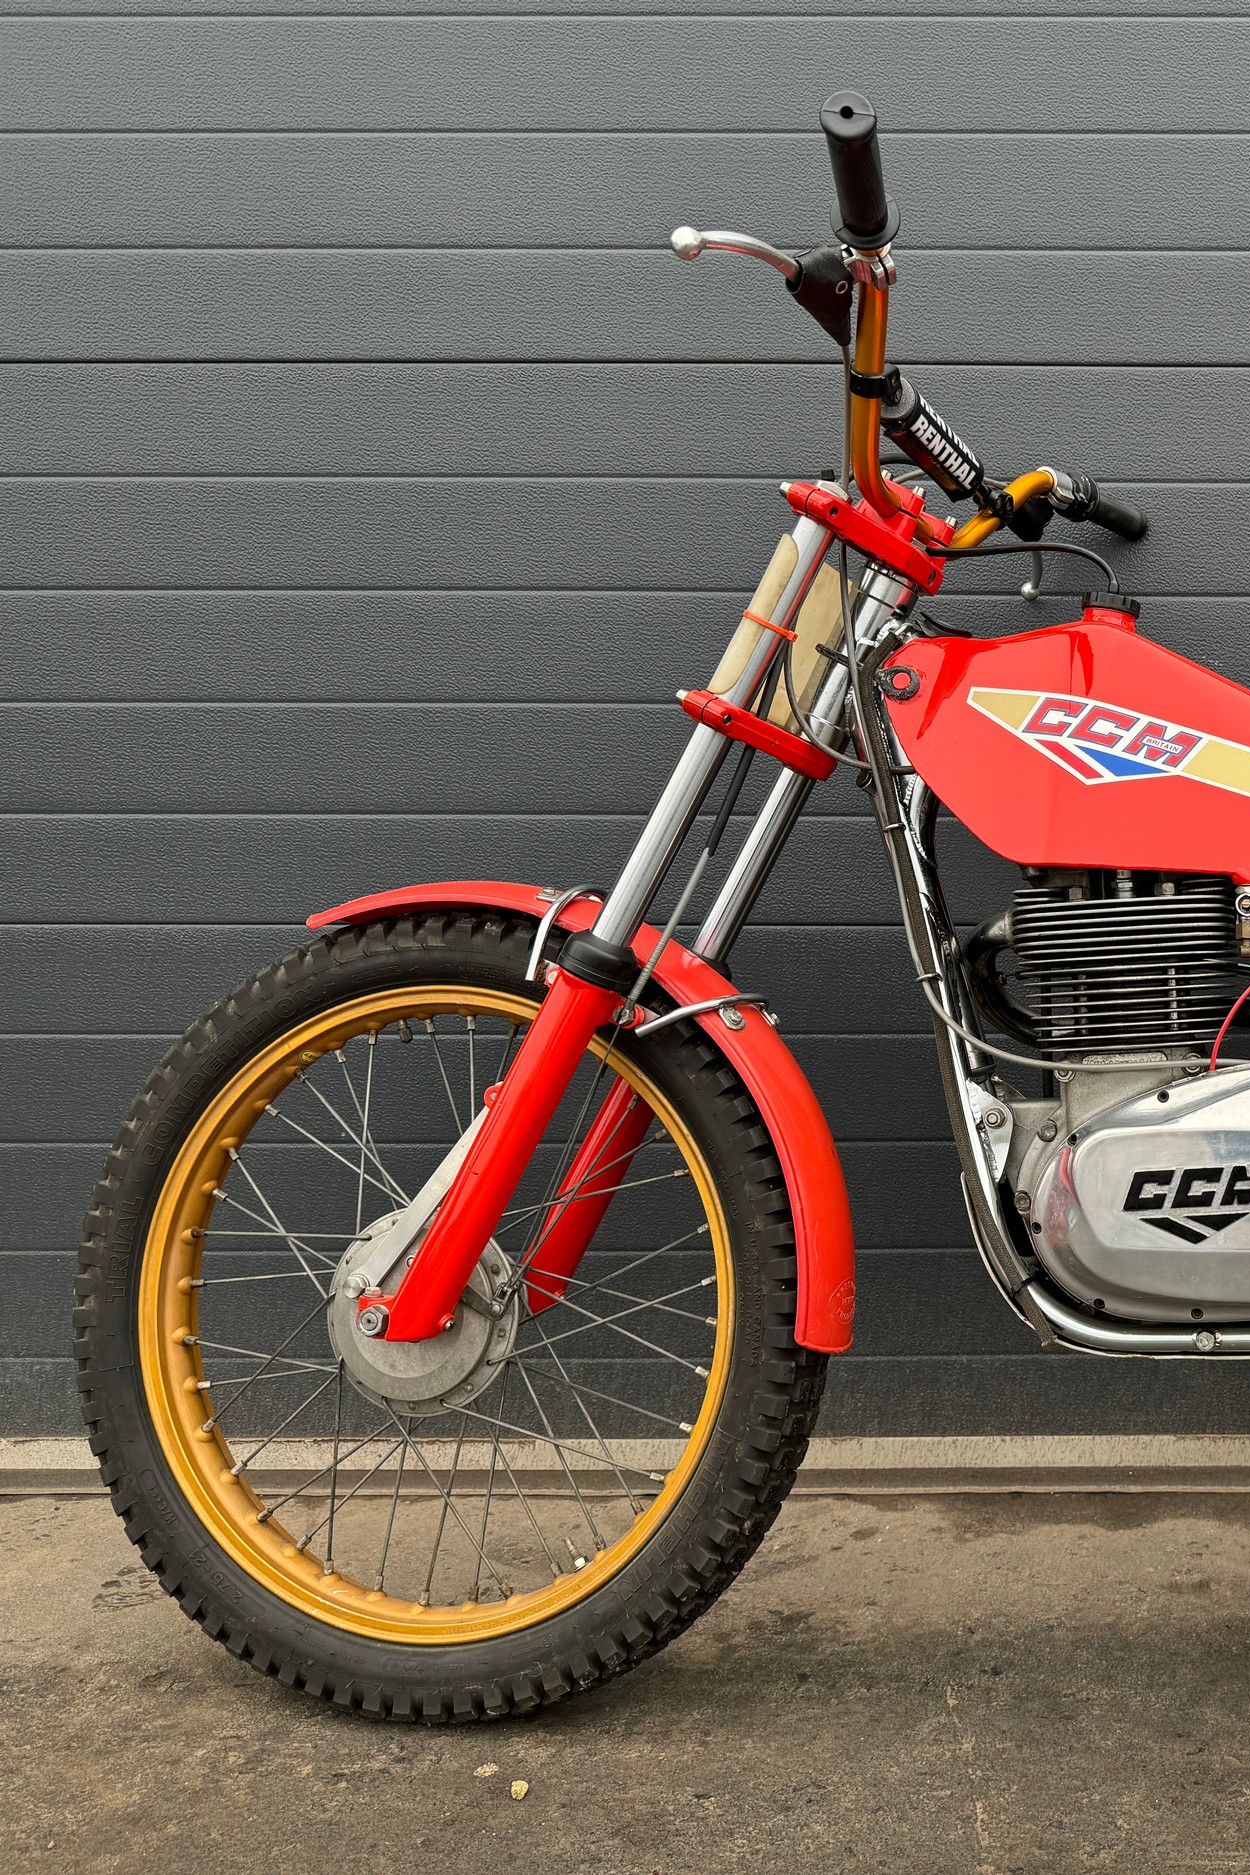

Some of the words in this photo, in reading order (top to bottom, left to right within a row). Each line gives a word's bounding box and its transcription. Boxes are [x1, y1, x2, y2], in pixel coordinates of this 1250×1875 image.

[910, 413, 977, 490] RENTHAL
[1022, 697, 1203, 768] CCM
[1145, 738, 1180, 752] BRITAIN
[105, 1195, 144, 1303] TRIAL
[141, 982, 323, 1168] COMPETITION
[617, 1435, 732, 1602] MICHELIN
